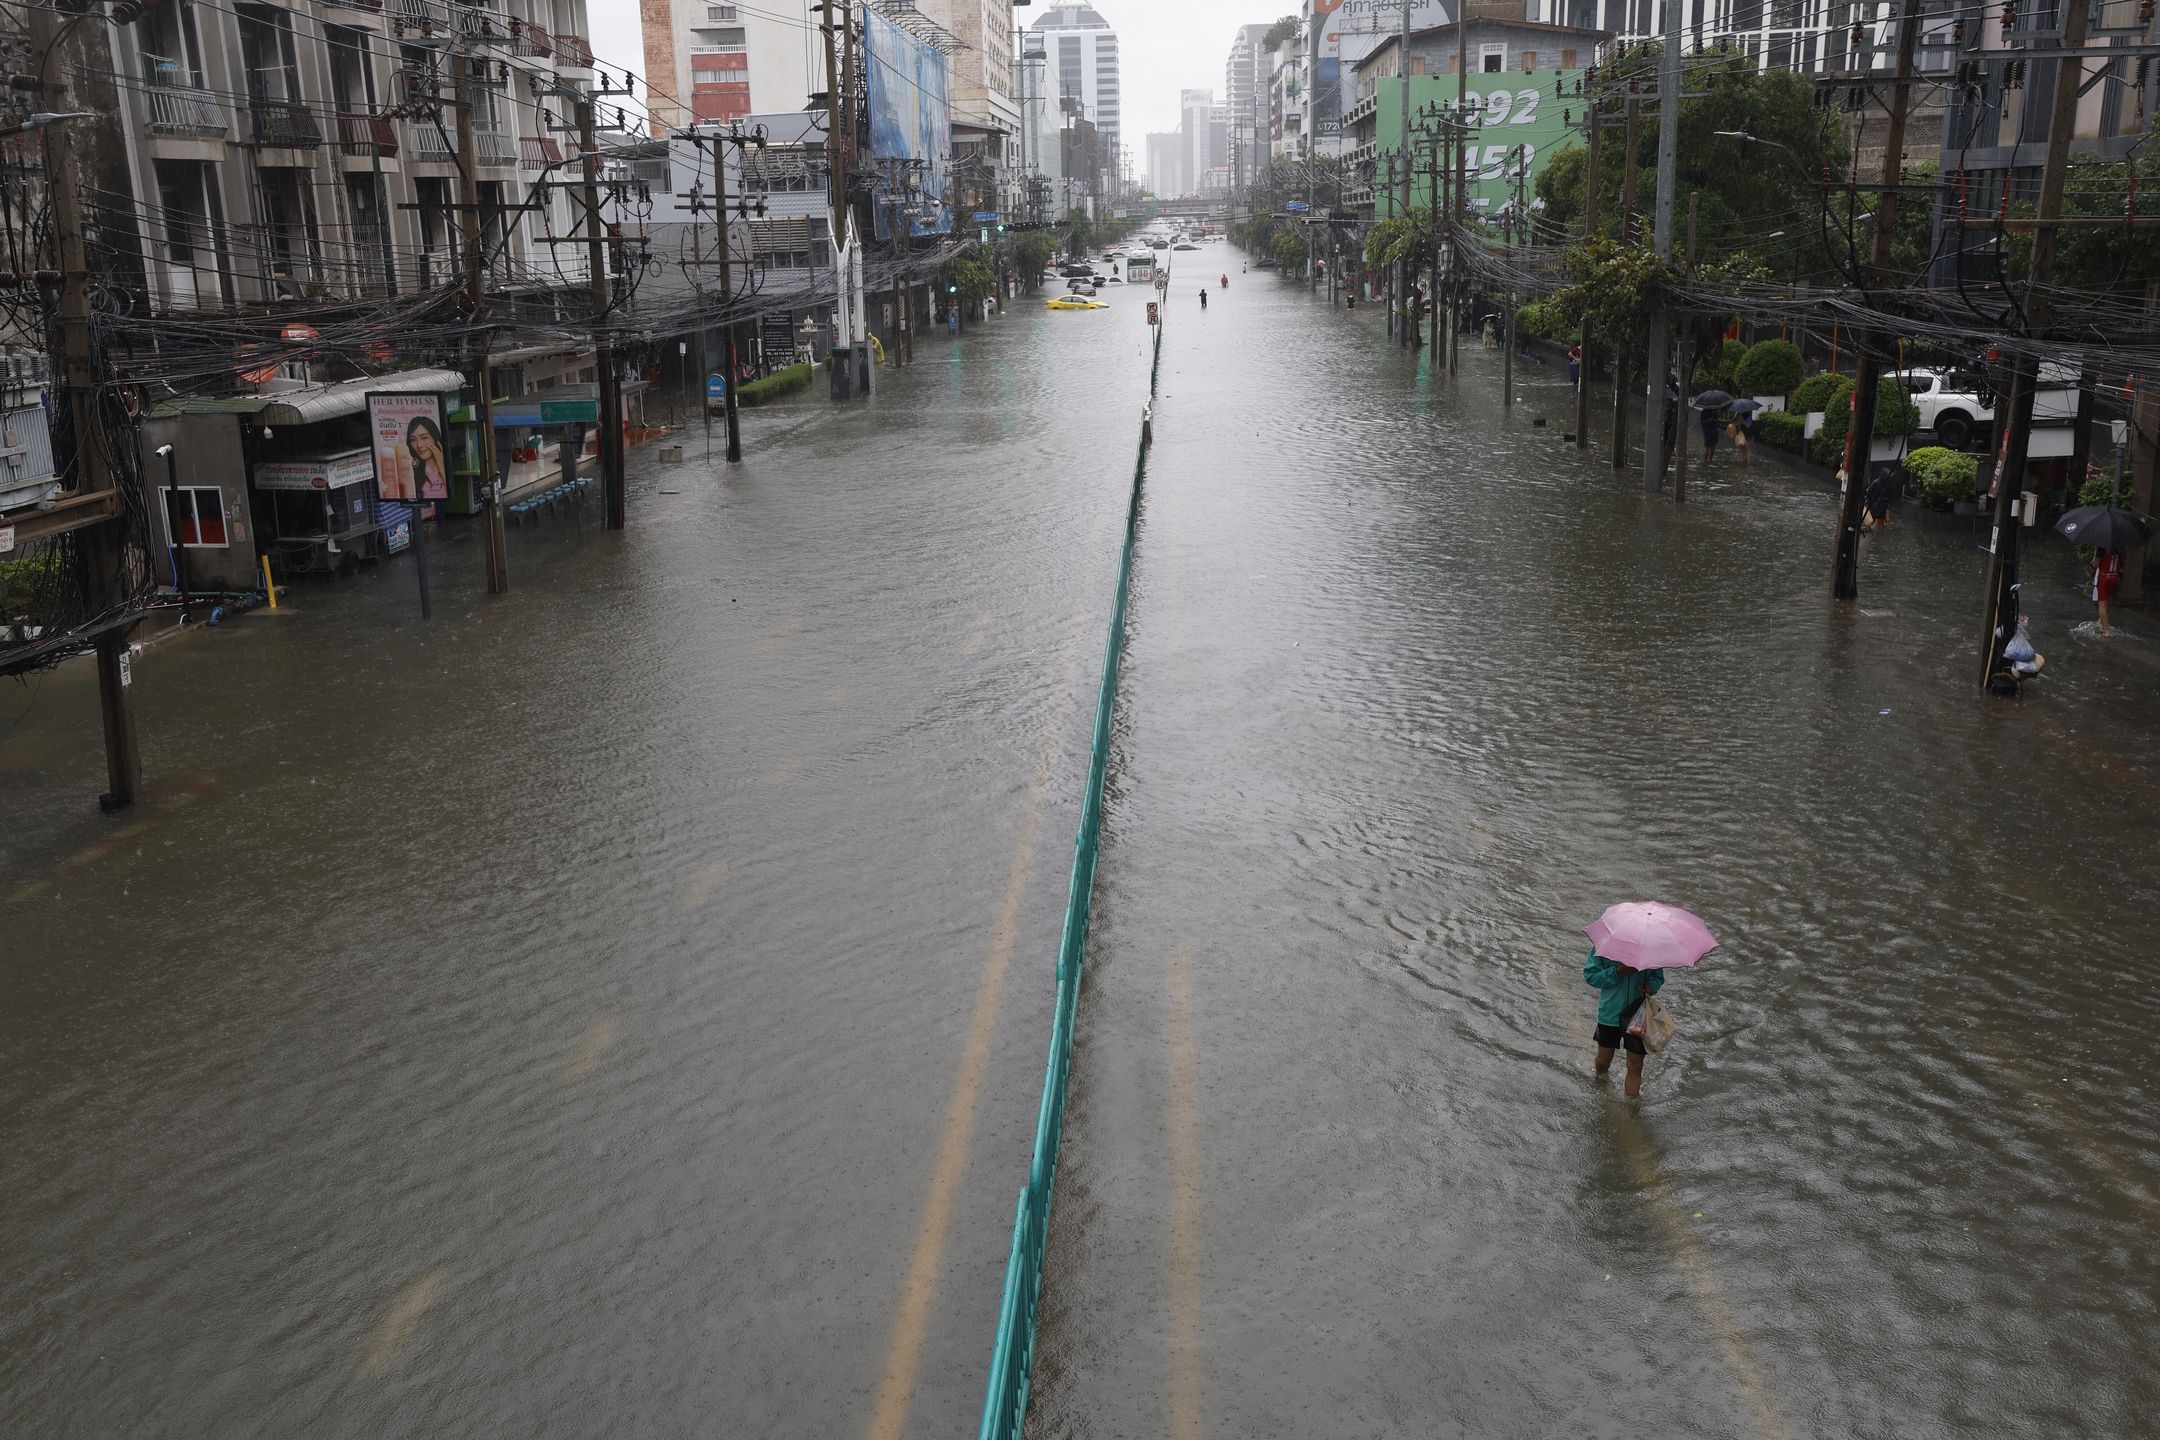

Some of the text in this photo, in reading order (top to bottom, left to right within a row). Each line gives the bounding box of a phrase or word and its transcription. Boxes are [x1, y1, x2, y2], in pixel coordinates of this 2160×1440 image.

[1342, 0, 1390, 17] ศุภาลย
[373, 397, 435, 405] HER HYNESS
